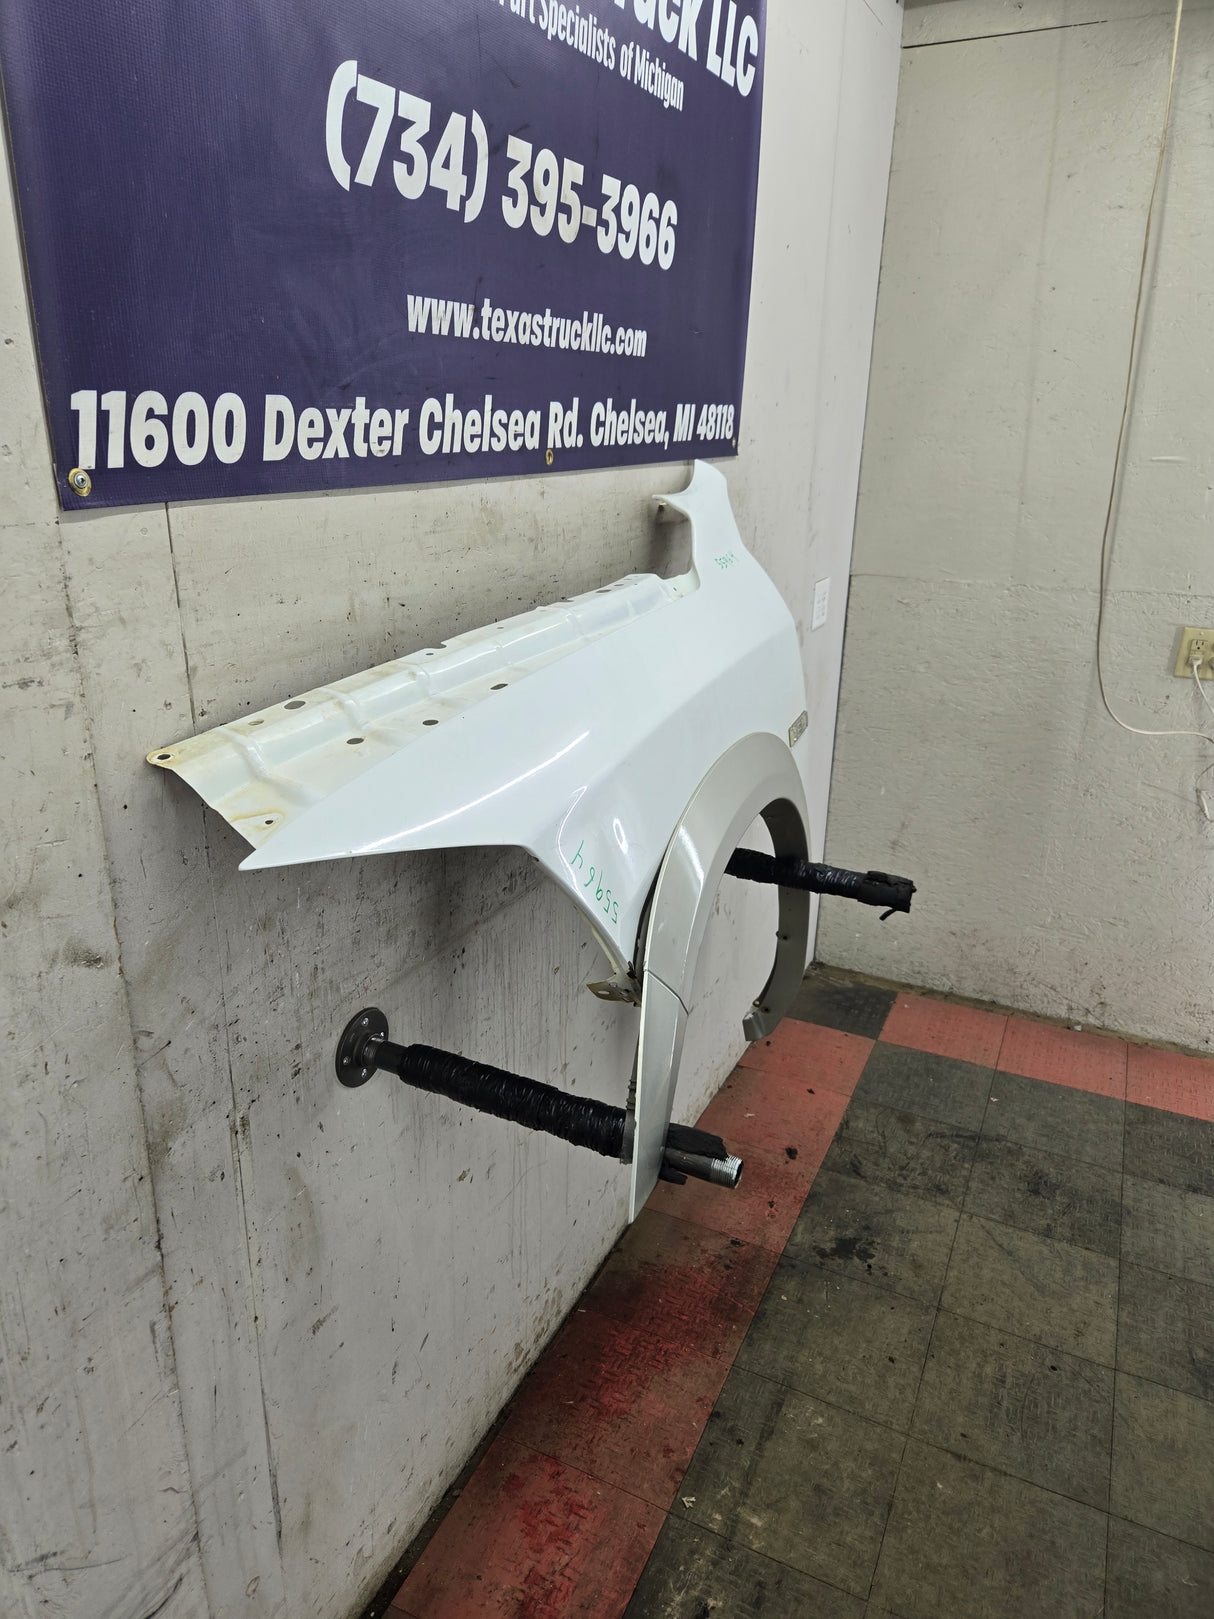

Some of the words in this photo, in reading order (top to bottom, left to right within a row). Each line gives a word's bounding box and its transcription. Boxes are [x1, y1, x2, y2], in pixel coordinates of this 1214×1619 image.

[538, 0, 617, 71] Specialists
[619, 41, 635, 81] of
[633, 44, 685, 112] Michigan
[613, 0, 699, 61] ck
[706, 0, 759, 97] LLC
[326, 60, 489, 224] (734)
[502, 134, 678, 270] 395-3966
[407, 294, 648, 357] www.texastruckllc.com
[70, 390, 247, 470] 11600
[262, 394, 410, 462] Dexter
[419, 393, 541, 455] Chelsea
[547, 397, 584, 449] Rd.
[590, 398, 670, 451] Chelsea,
[673, 404, 696, 442] MI
[697, 404, 735, 440] 48118
